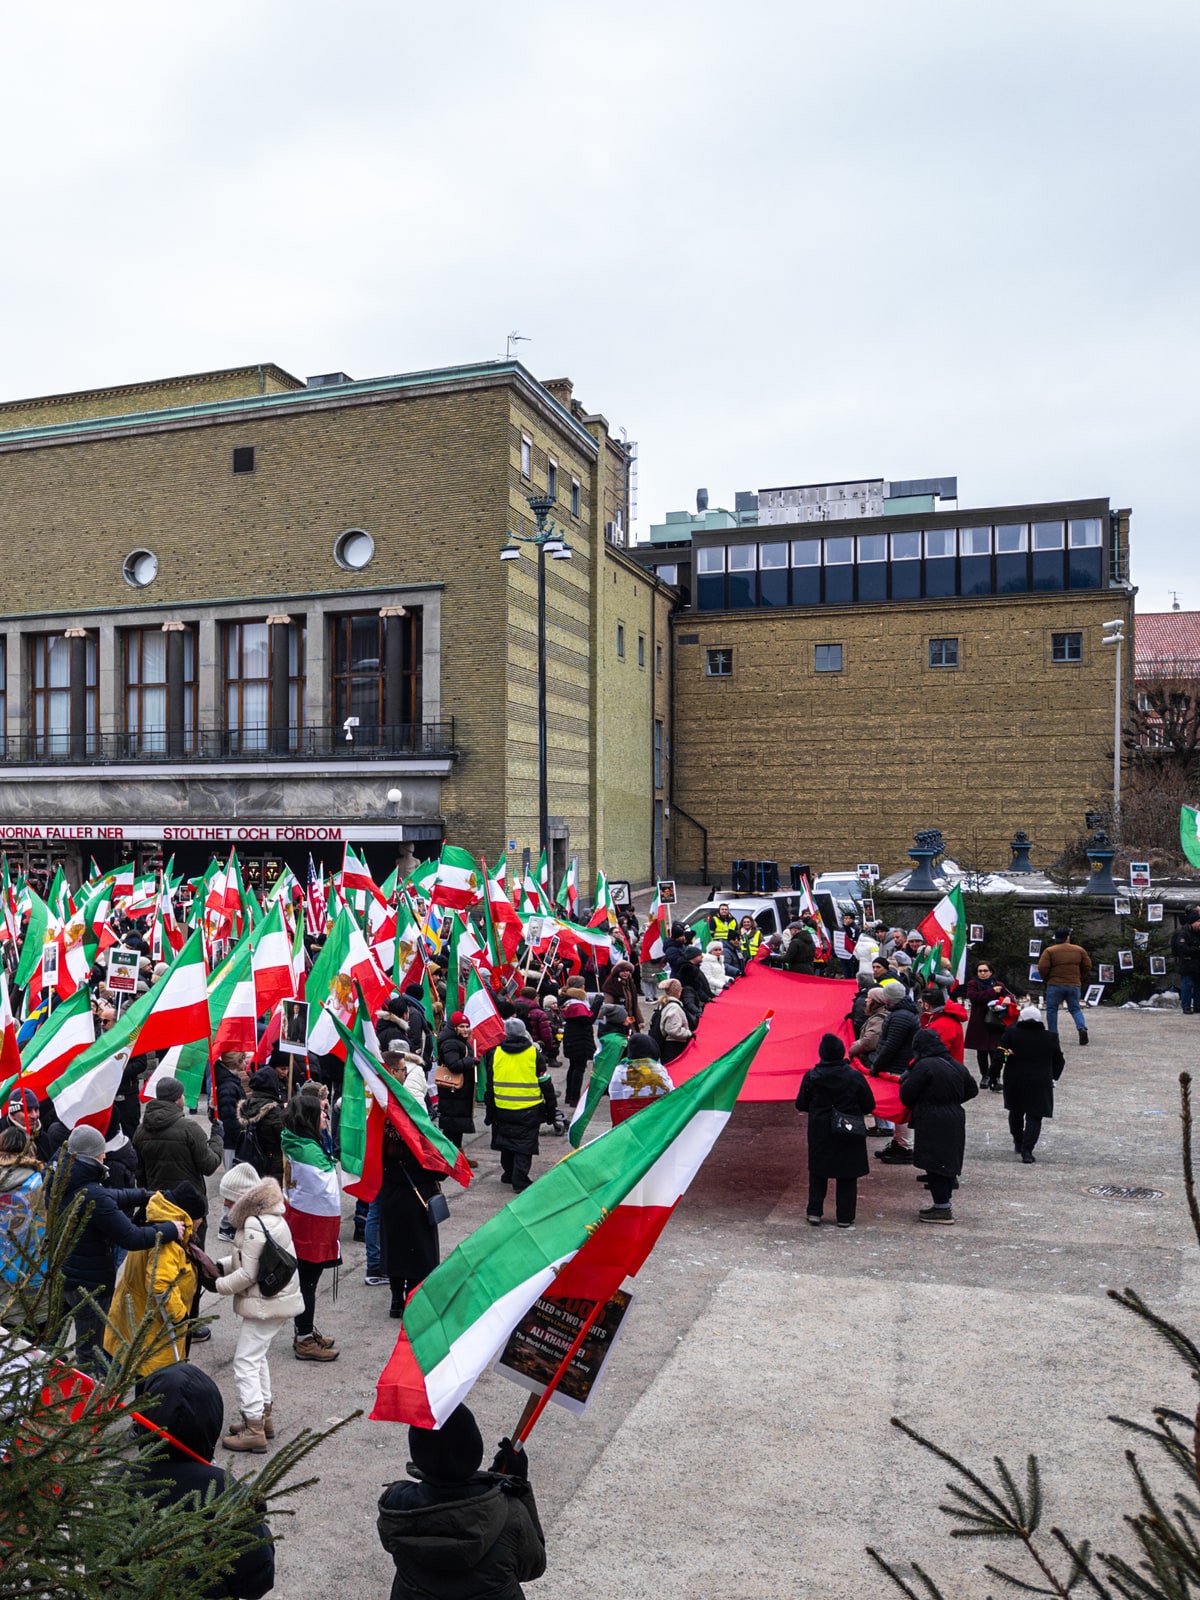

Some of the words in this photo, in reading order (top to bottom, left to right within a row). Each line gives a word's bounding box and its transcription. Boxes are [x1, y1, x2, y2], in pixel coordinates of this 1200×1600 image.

[47, 826, 93, 838] FALLER
[97, 827, 124, 839] NER
[163, 827, 233, 840] STOLTHET
[237, 827, 269, 840] OCH
[276, 825, 342, 840] FÖRDOM
[561, 1311, 580, 1326] TWO
[530, 1326, 544, 1338] ALI
[544, 1333, 587, 1359] KHAMEEI
[515, 1331, 526, 1340] The
[525, 1336, 541, 1349] World
[540, 1343, 554, 1355] Must
[575, 1361, 591, 1373] Away
